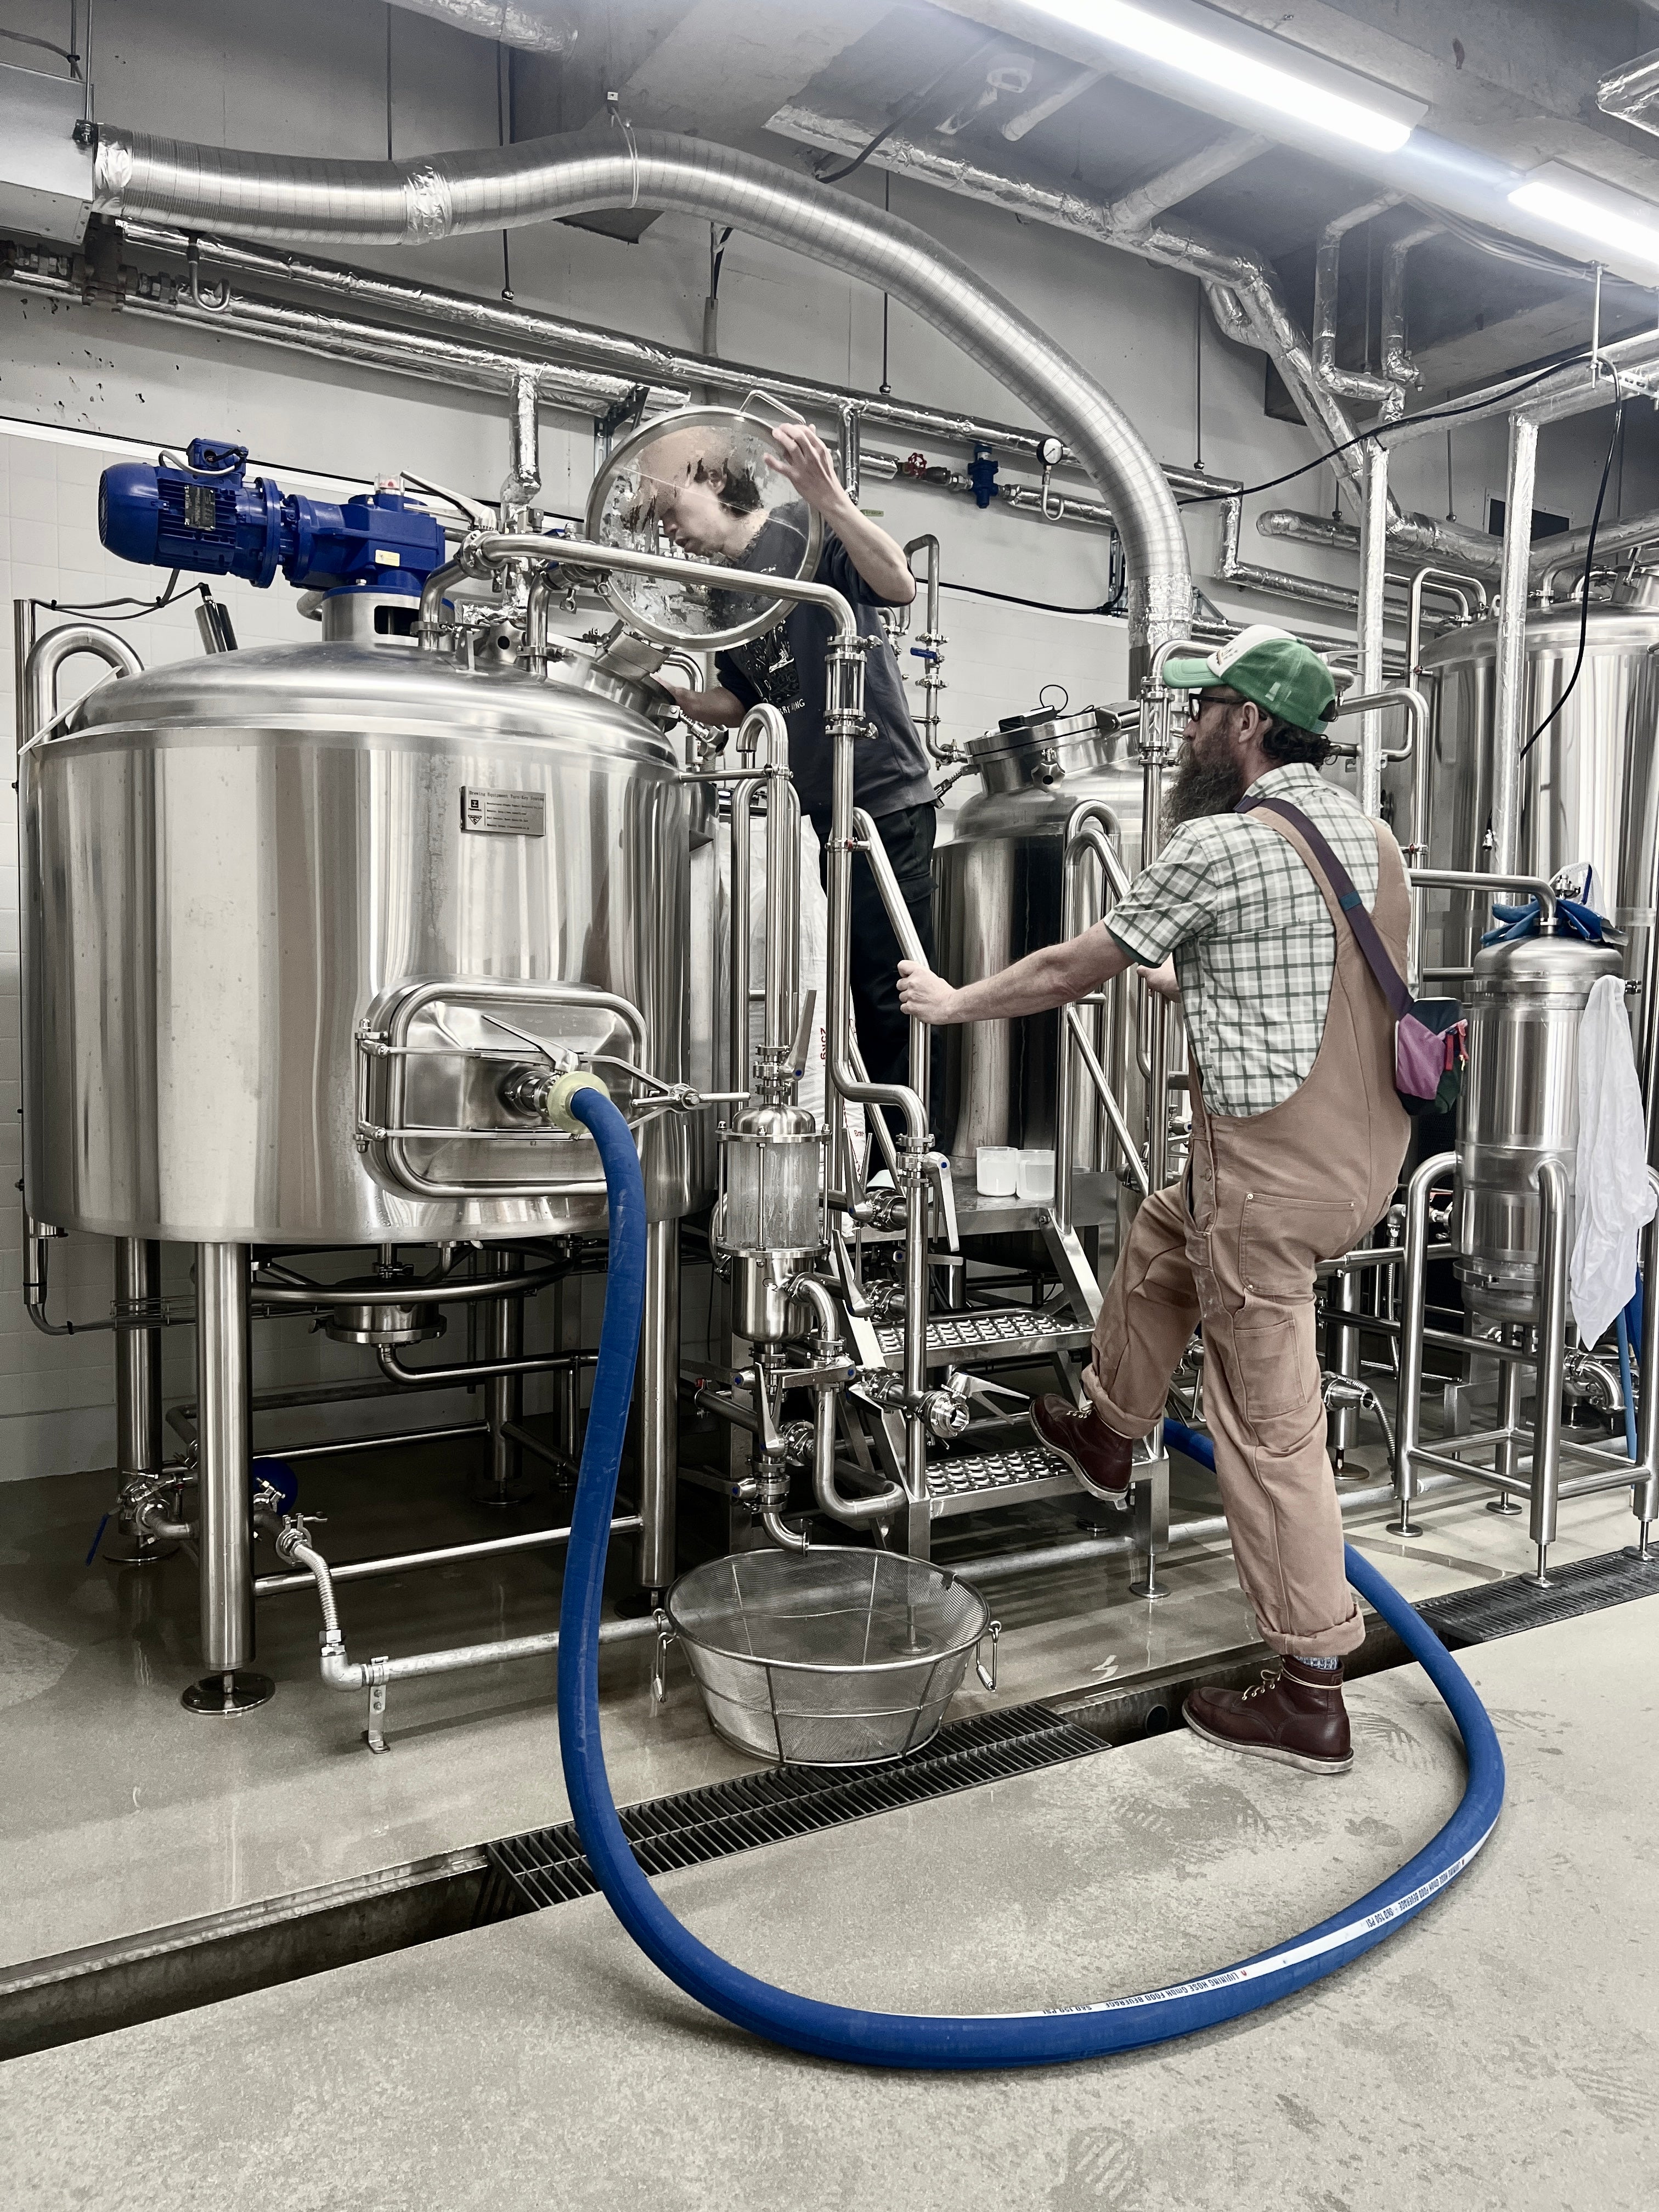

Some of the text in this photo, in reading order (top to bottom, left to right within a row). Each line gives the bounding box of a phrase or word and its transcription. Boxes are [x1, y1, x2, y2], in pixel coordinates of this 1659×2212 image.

[1418, 1885, 1429, 1898] FOOD
[1398, 1892, 1419, 1911] BEVERAGE
[1365, 1916, 1375, 1928] PSI
[1375, 1913, 1385, 1925] 150
[1165, 1987, 1188, 1997] GmbH
[1188, 1981, 1209, 1992] HOSE
[1105, 1996, 1144, 2008] BEVERAGE
[1144, 1992, 1165, 2001] FOOD
